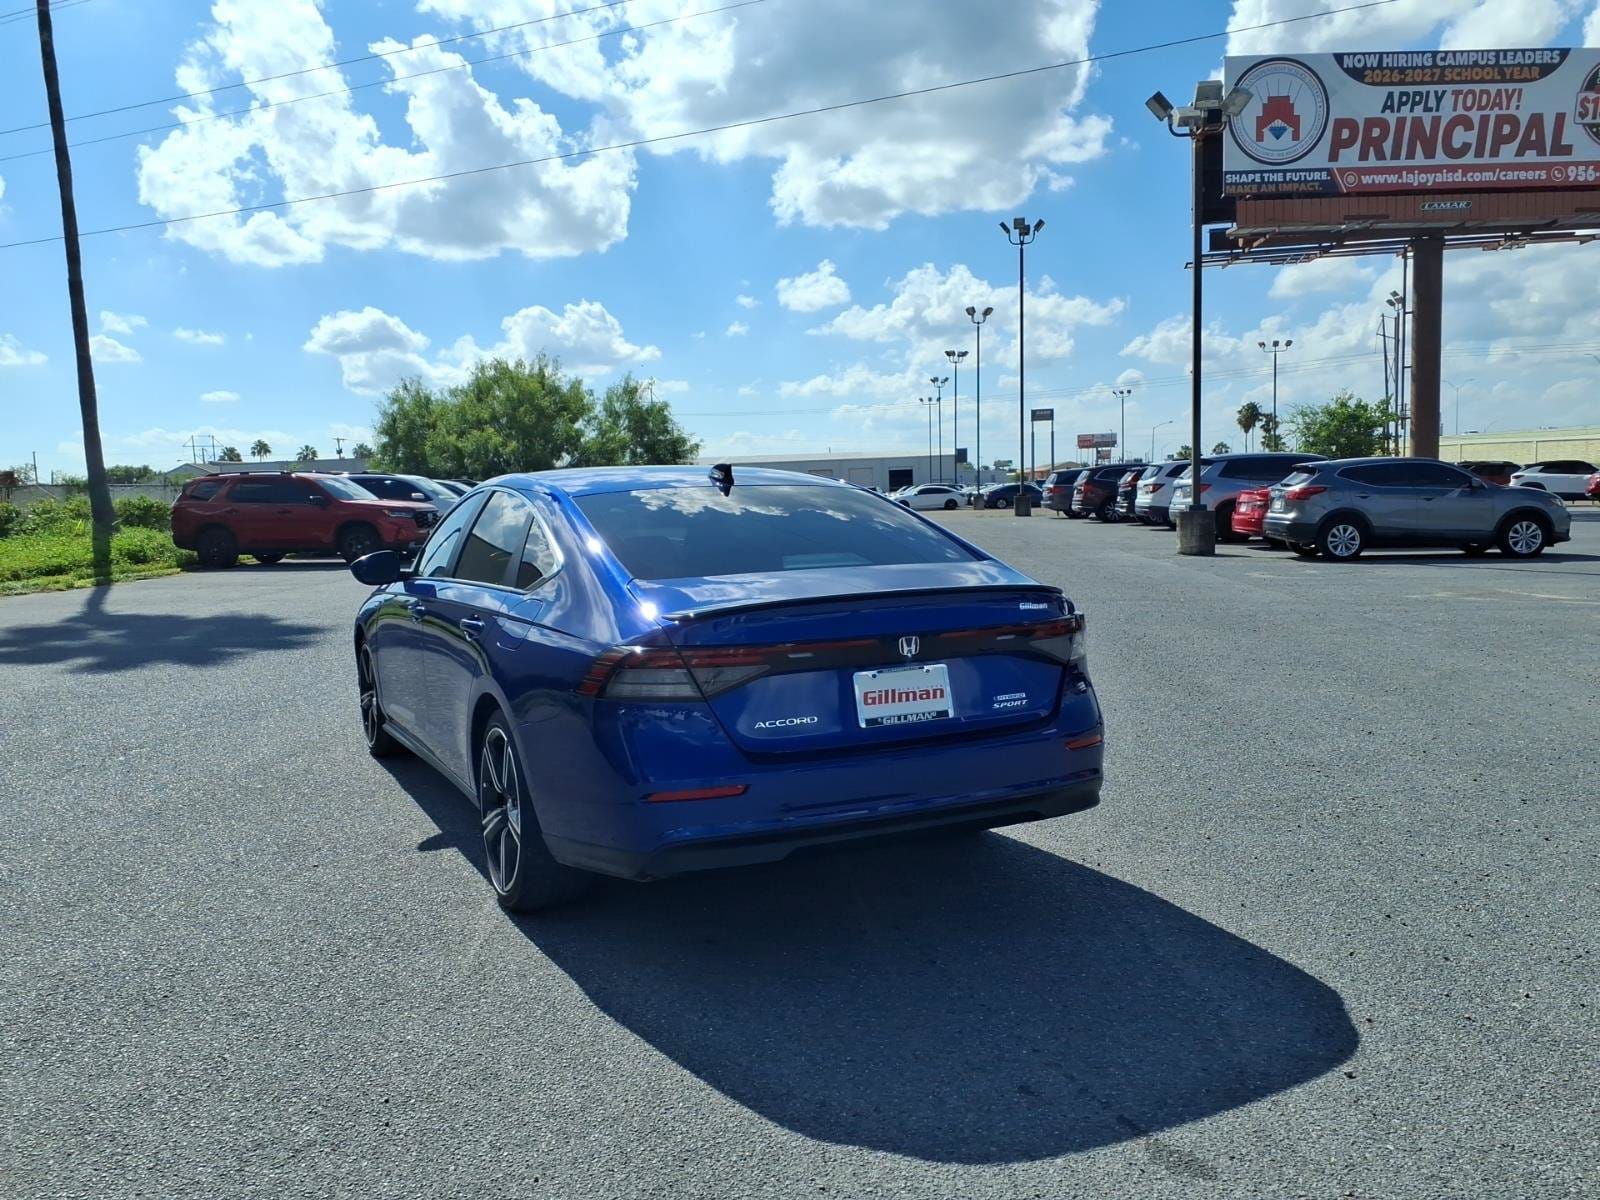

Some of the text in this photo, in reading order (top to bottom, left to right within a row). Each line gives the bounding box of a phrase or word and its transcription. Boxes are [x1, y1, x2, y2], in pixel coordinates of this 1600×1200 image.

[1343, 50, 1561, 69] NOW HIRING CAMPUS LEADERS
[1363, 66, 1541, 83] 2026-2027 SCHOOL YEAR
[1381, 88, 1523, 113] APPLY TODAY!
[1327, 112, 1574, 162] PRINCIPAL
[1225, 171, 1331, 183] SHAPE THE FUTURE.
[1360, 168, 1547, 186] www.lajoyaisd.com/careers
[1225, 182, 1323, 194] MAKE AN IMPACT.
[1423, 201, 1467, 209] LAMAR
[1019, 602, 1048, 610] Gillman
[863, 688, 945, 706] Gillman
[991, 699, 1028, 709] SPORT
[754, 716, 818, 729] ACCORD
